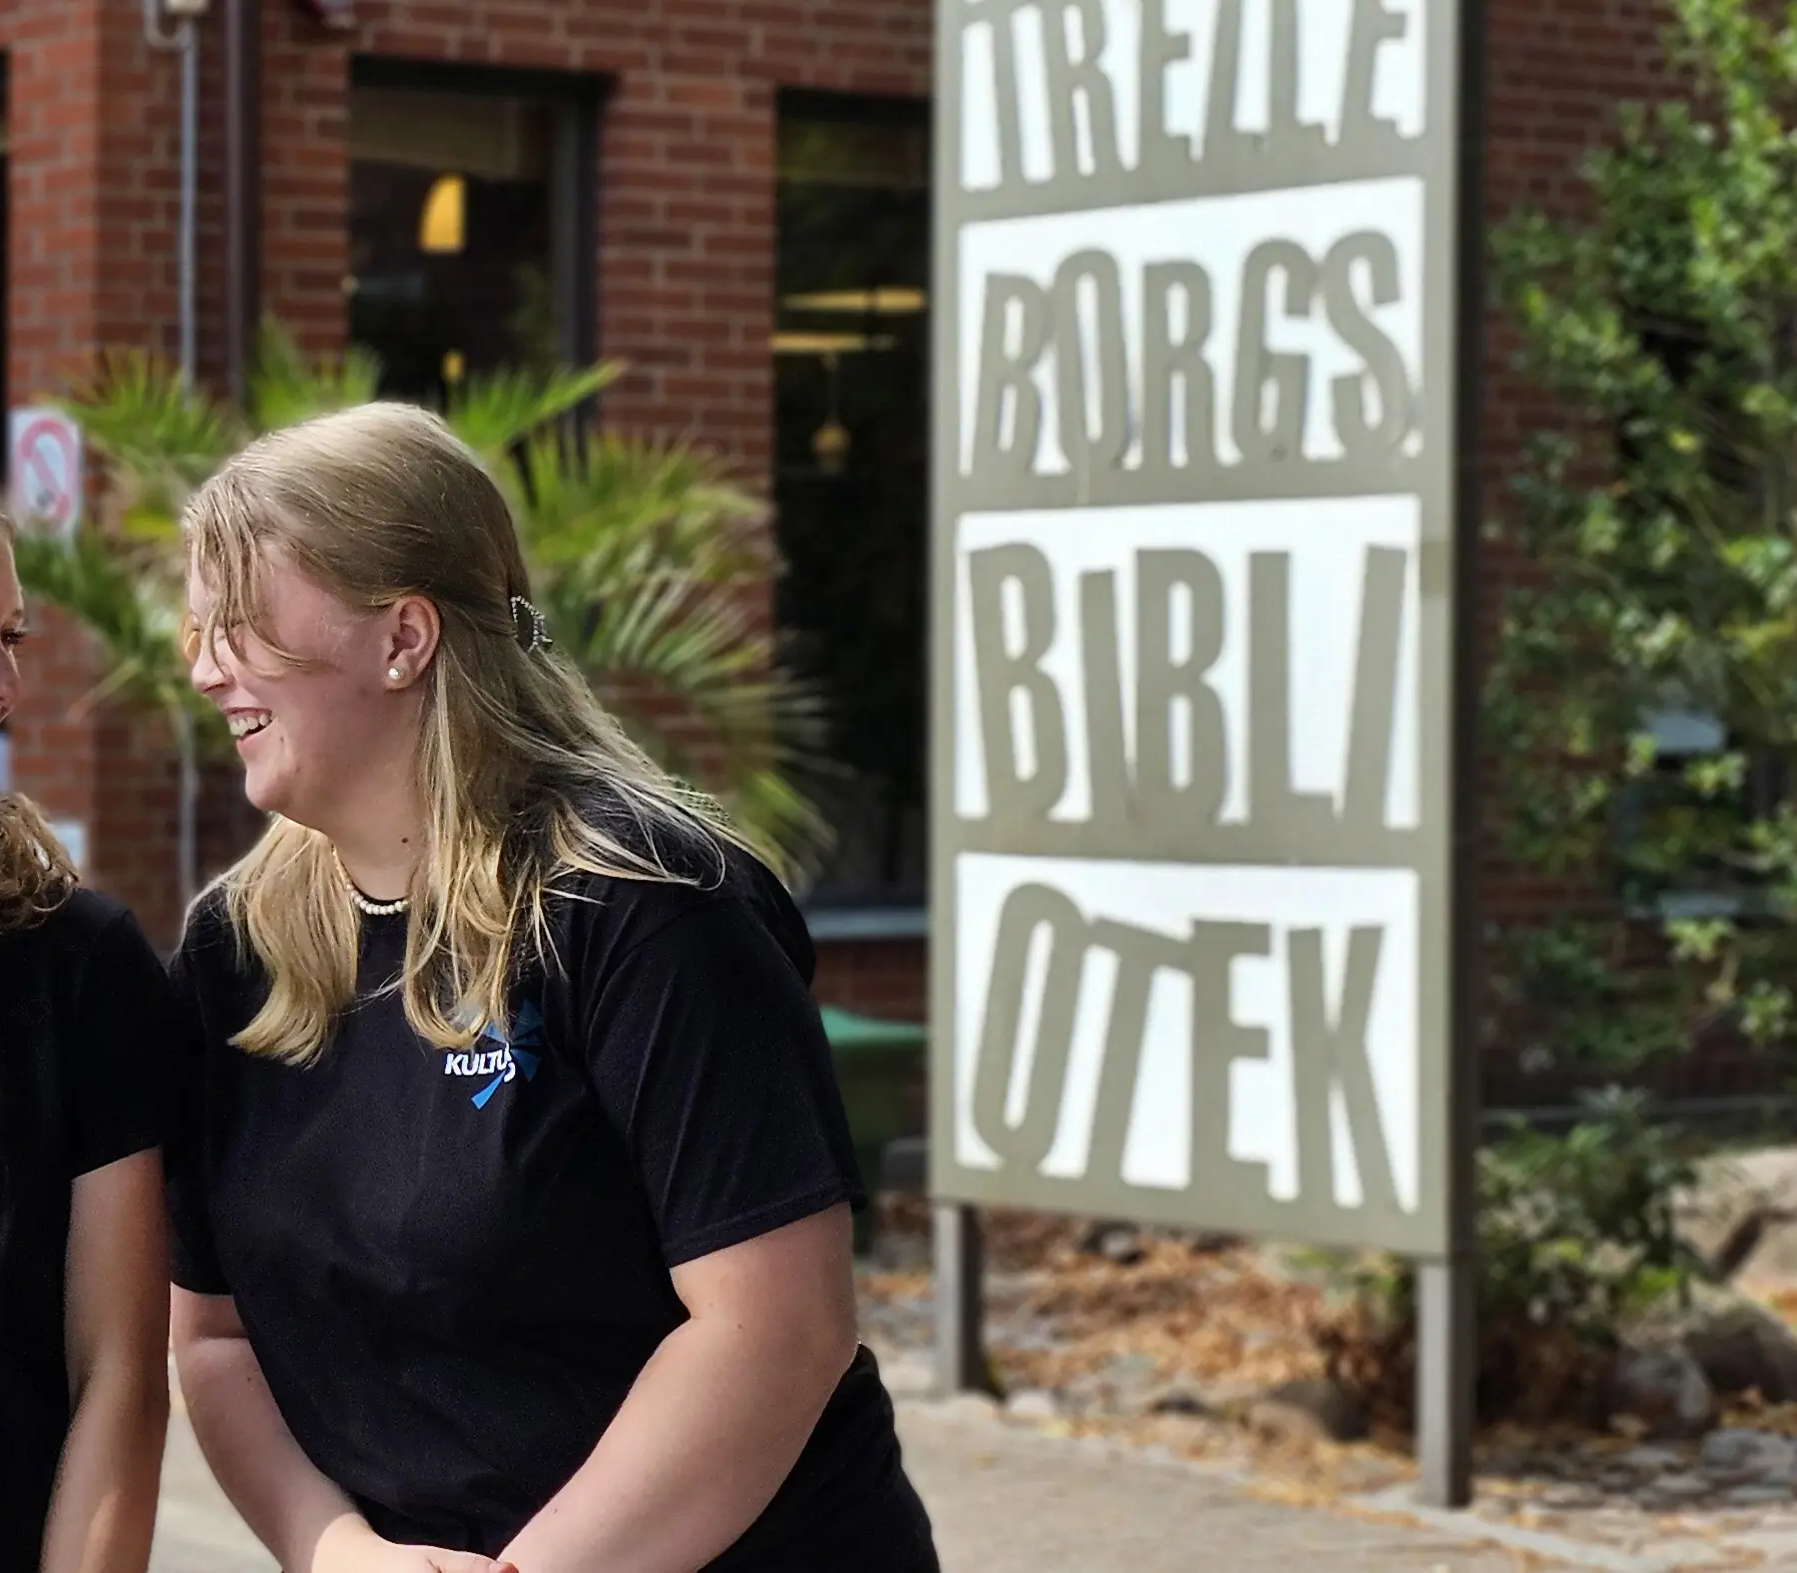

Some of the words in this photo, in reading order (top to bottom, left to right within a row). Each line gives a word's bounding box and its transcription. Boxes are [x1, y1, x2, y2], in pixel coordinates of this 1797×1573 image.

[969, 231, 1407, 476] BORGS
[968, 541, 1408, 827] BIBLI
[444, 1043, 514, 1077] KULTU
[970, 881, 1406, 1208] OTEK
